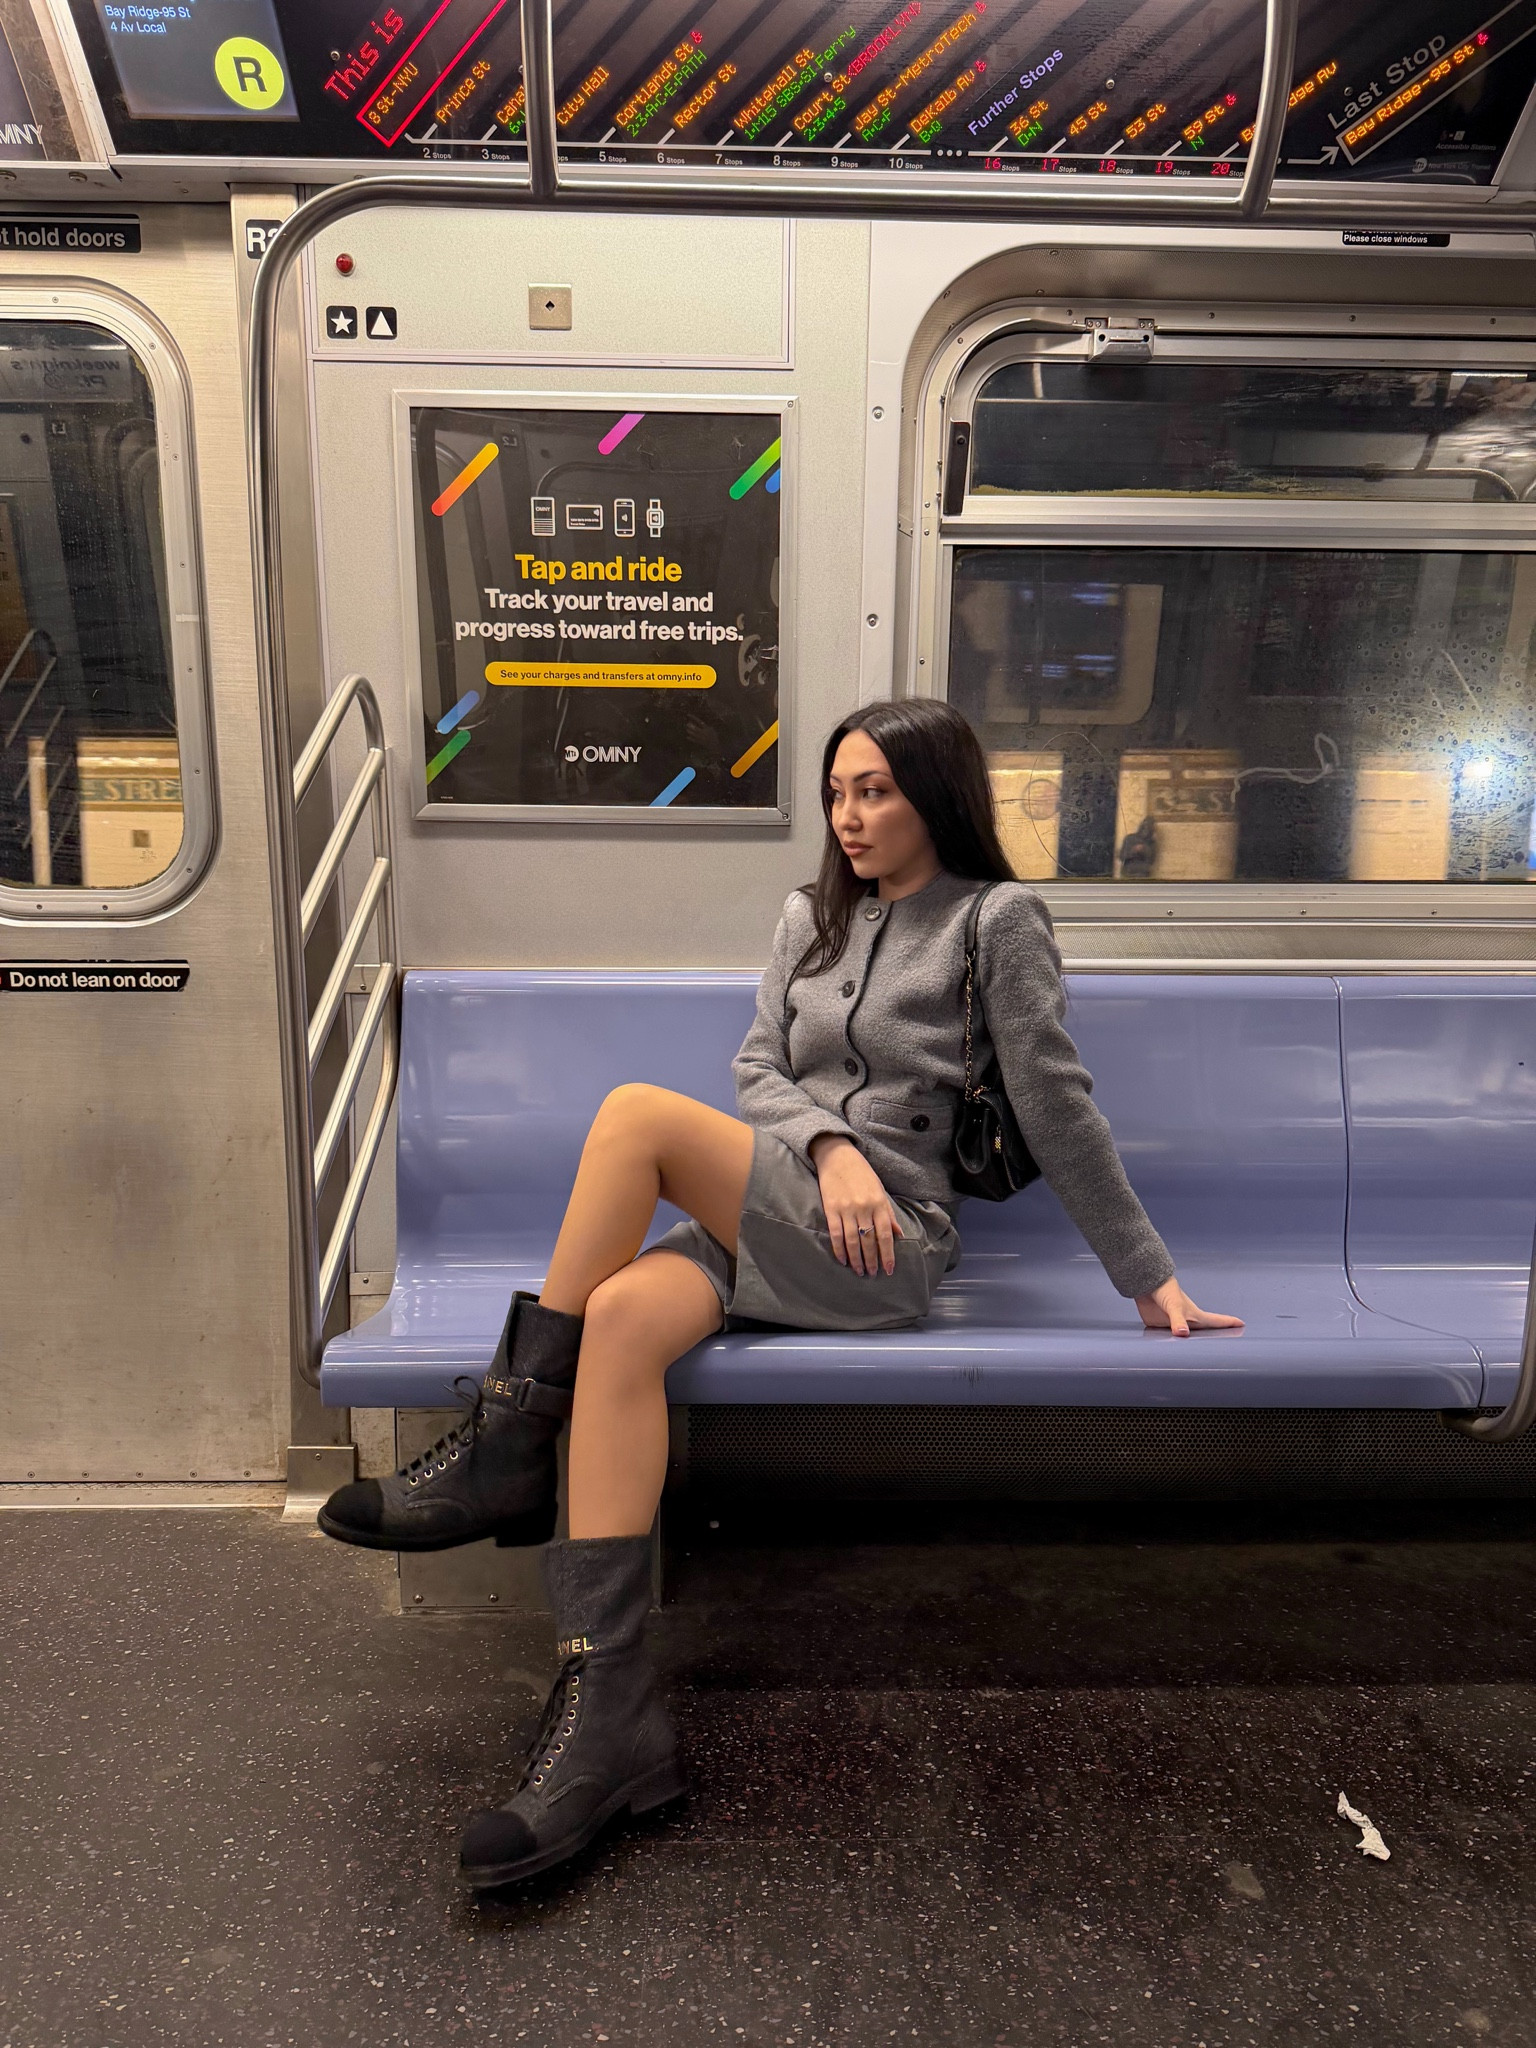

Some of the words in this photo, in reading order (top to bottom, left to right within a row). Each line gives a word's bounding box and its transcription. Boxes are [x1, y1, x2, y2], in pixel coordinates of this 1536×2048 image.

[105, 5, 126, 19] Bay
[128, 6, 176, 19] Ridge-95
[179, 7, 191, 18] St
[110, 21, 118, 31] 4
[120, 22, 134, 32] Av
[136, 22, 167, 33] Local
[324, 41, 380, 100] This
[370, 8, 404, 45] is
[815, 25, 856, 70] Ferry
[233, 56, 267, 92] R
[615, 60, 677, 127] Cortlandt
[674, 42, 694, 62] St
[1327, 81, 1383, 130] Last
[1386, 35, 1446, 85] Stop
[368, 111, 382, 125] 8
[376, 62, 419, 114] St-NYU
[436, 77, 476, 124] Prince
[472, 59, 491, 80] St
[556, 95, 585, 125] City
[581, 65, 609, 97] Hall
[674, 80, 717, 129] Rector
[717, 64, 737, 83] St
[733, 66, 797, 129] Whitehall
[795, 48, 815, 68] St
[968, 87, 1019, 136] Further
[1019, 49, 1064, 90] Stops
[1287, 80, 1315, 111] dge
[1316, 62, 1337, 84] Av
[1345, 118, 1376, 145] Bay
[1377, 61, 1451, 123] Ridge-95
[1453, 44, 1475, 64] St
[793, 92, 833, 131] Court
[832, 74, 851, 93] St
[910, 89, 957, 132] DeKalb
[956, 69, 975, 91] Av
[855, 104, 879, 131] Jay
[1009, 116, 1030, 136] 36
[1028, 99, 1049, 120] St
[1068, 117, 1088, 136] 45
[1087, 101, 1107, 121] St
[1125, 119, 1146, 140] 53
[1147, 103, 1166, 122] St
[1183, 120, 1204, 140] 59
[1204, 104, 1225, 125] St
[0, 124, 42, 144] MNY
[1190, 135, 1205, 151] N
[423, 147, 431, 158] 2
[481, 148, 490, 160] 3
[599, 151, 606, 162] 5
[657, 152, 665, 164] 6
[667, 157, 685, 165] Stops
[715, 153, 723, 165] 7
[724, 158, 743, 166] Stops
[773, 155, 781, 166] 8
[782, 159, 801, 167] Stops
[831, 156, 839, 167] 9
[840, 160, 859, 168] Stops
[889, 158, 904, 169] 10
[905, 161, 924, 169] Stops
[984, 157, 1001, 170] 16
[1001, 164, 1020, 172] Stops
[1041, 158, 1059, 171] 17
[1098, 160, 1117, 172] 18
[1115, 167, 1134, 175] Stops
[1155, 161, 1174, 174] 19
[1173, 168, 1191, 176] Stops
[1211, 163, 1230, 175] 20
[14, 227, 60, 246] hold
[66, 228, 126, 247] doors
[1343, 234, 1370, 242] Please
[1394, 235, 1428, 243] windows
[515, 554, 567, 585] Tap
[571, 556, 623, 581] and
[628, 556, 682, 582] ride
[484, 588, 549, 610] Track
[552, 593, 601, 613] your
[605, 592, 668, 612] travel
[672, 592, 714, 612] and
[455, 620, 555, 642] progress
[558, 620, 636, 640] toward
[640, 620, 685, 641] free
[689, 621, 744, 645] trips.
[500, 669, 518, 679] See
[520, 671, 541, 681] your
[543, 671, 581, 681] charges
[583, 671, 600, 680] and
[602, 671, 644, 681] transfers
[646, 672, 655, 681] at
[657, 672, 702, 683] omny.info
[583, 745, 642, 763] OMNY
[104, 780, 181, 800] STRE
[9, 971, 36, 988] Do
[38, 972, 69, 987] not
[72, 971, 111, 987] lean
[113, 975, 136, 987] on
[139, 971, 181, 988] door
